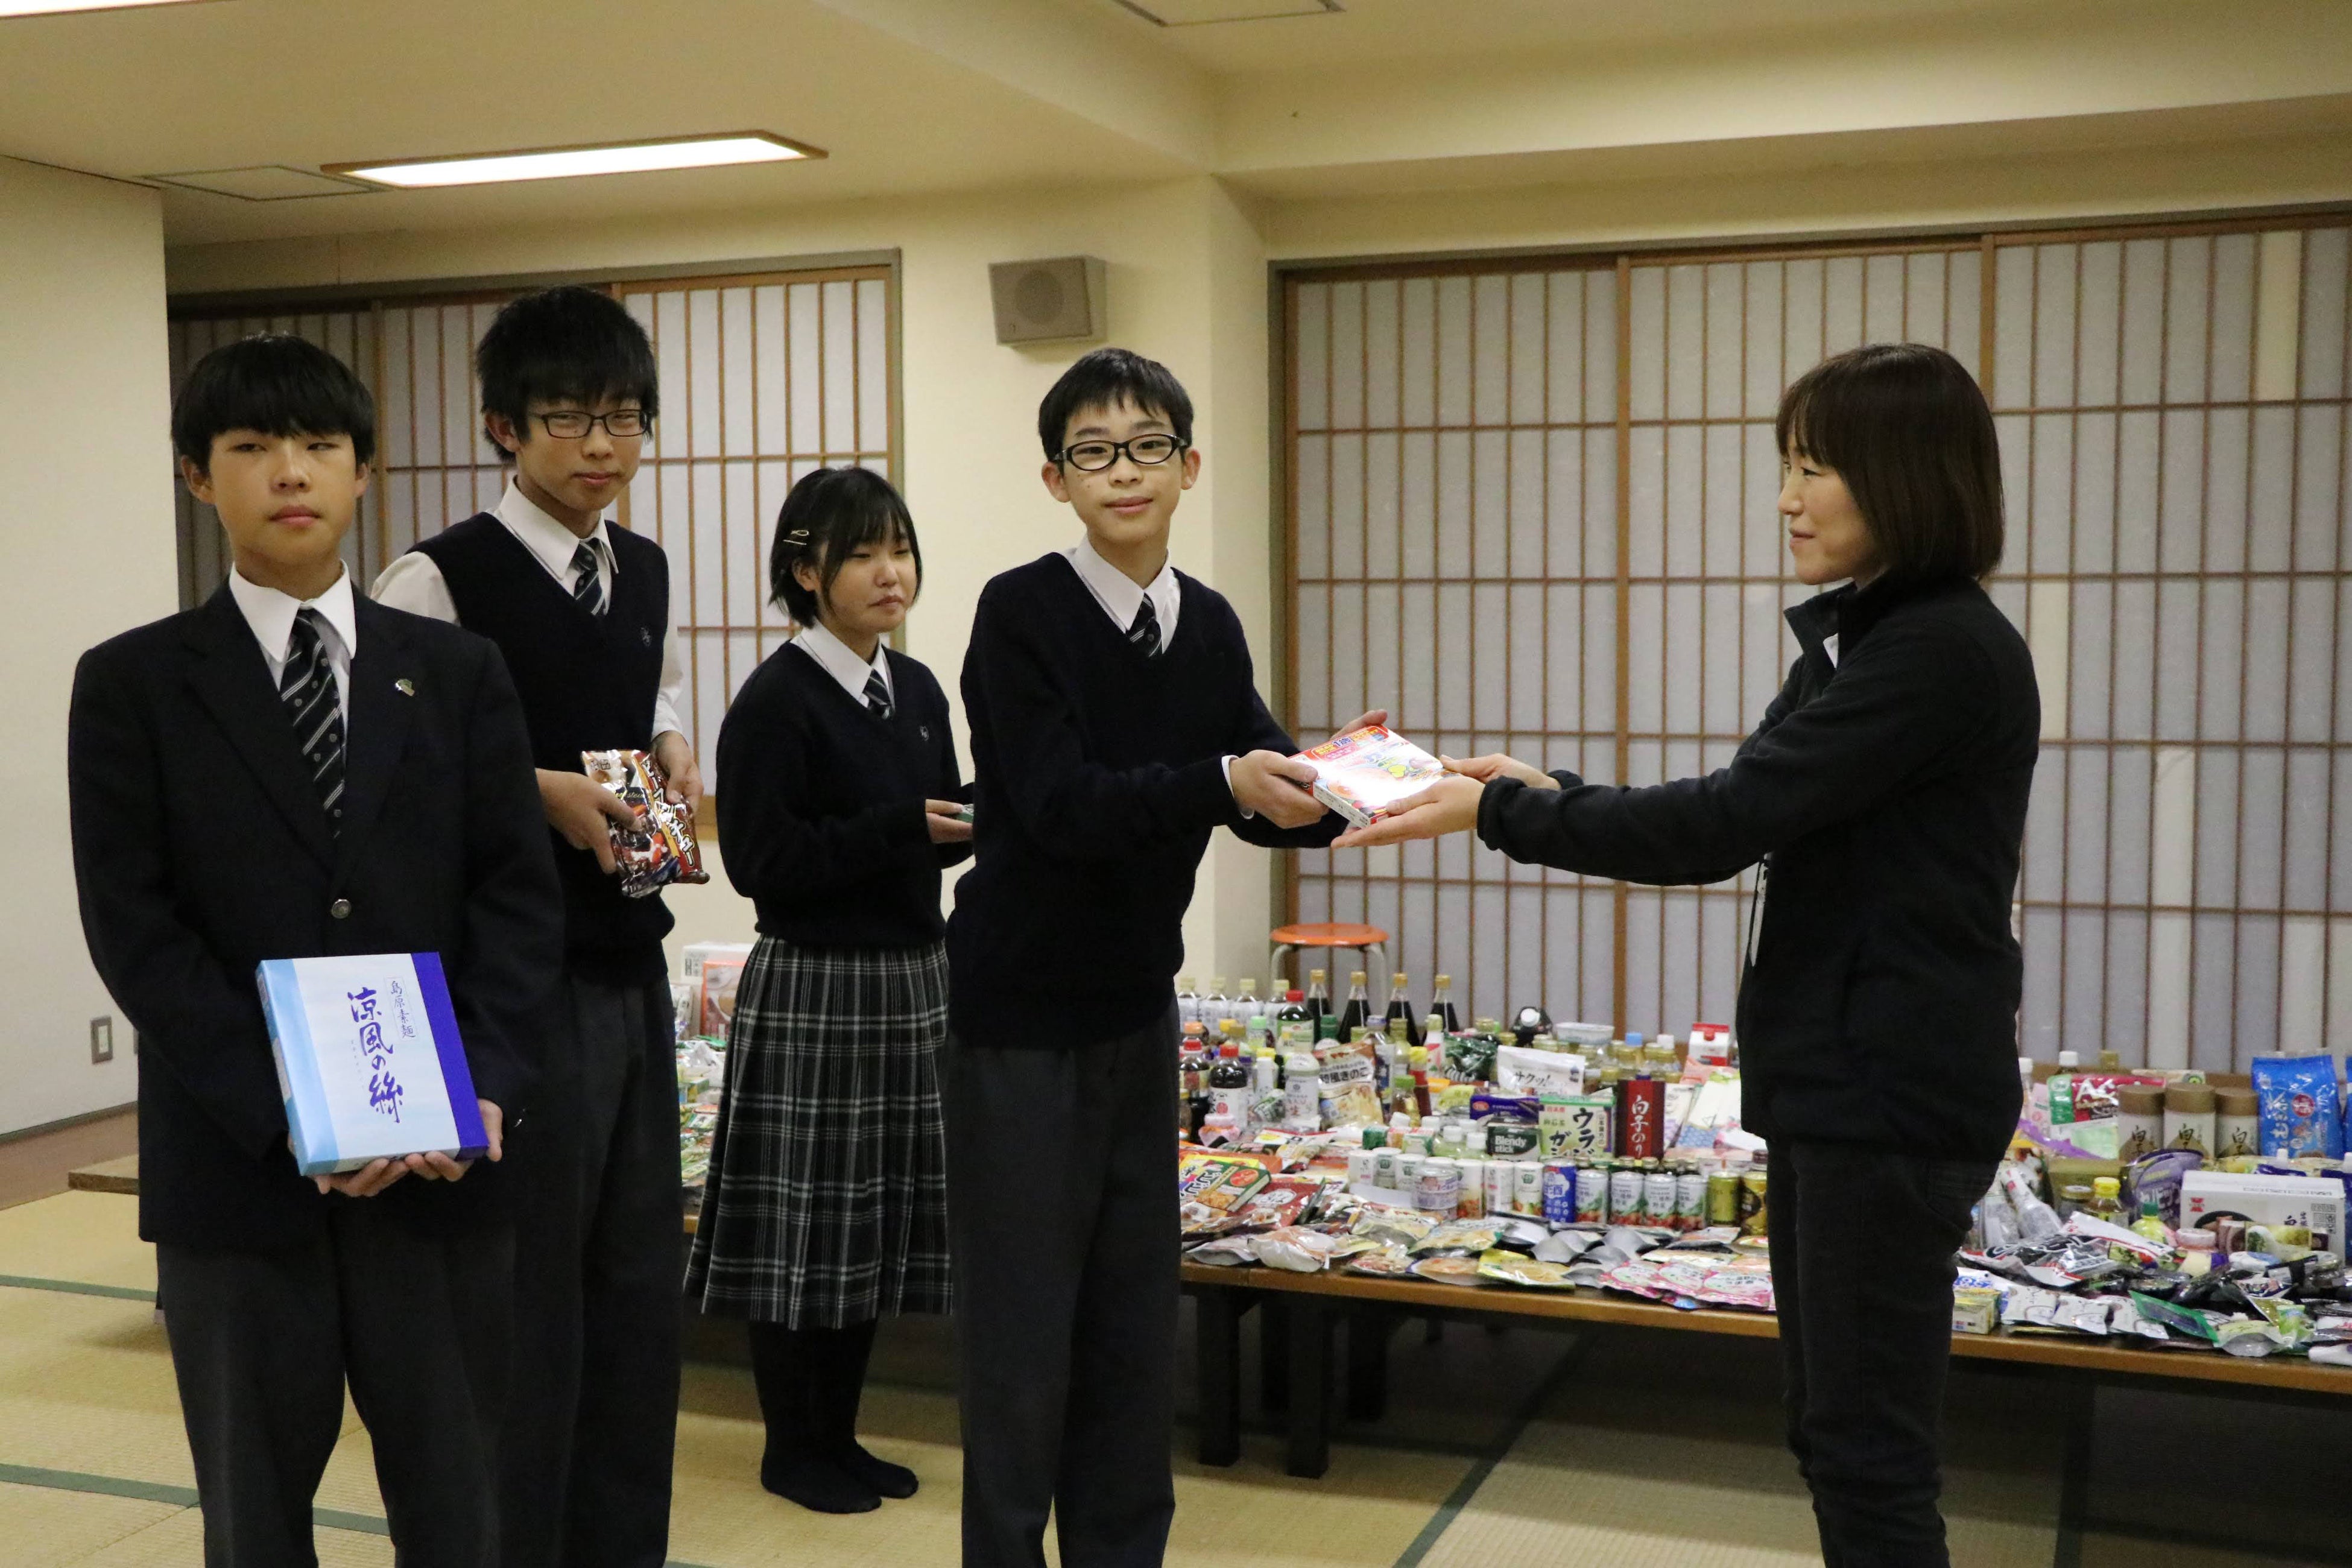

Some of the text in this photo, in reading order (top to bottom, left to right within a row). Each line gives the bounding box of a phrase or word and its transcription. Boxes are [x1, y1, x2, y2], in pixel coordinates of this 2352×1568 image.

[1495, 1136, 1527, 1148] Blendy
[1630, 1095, 1649, 1158] 白子のり
